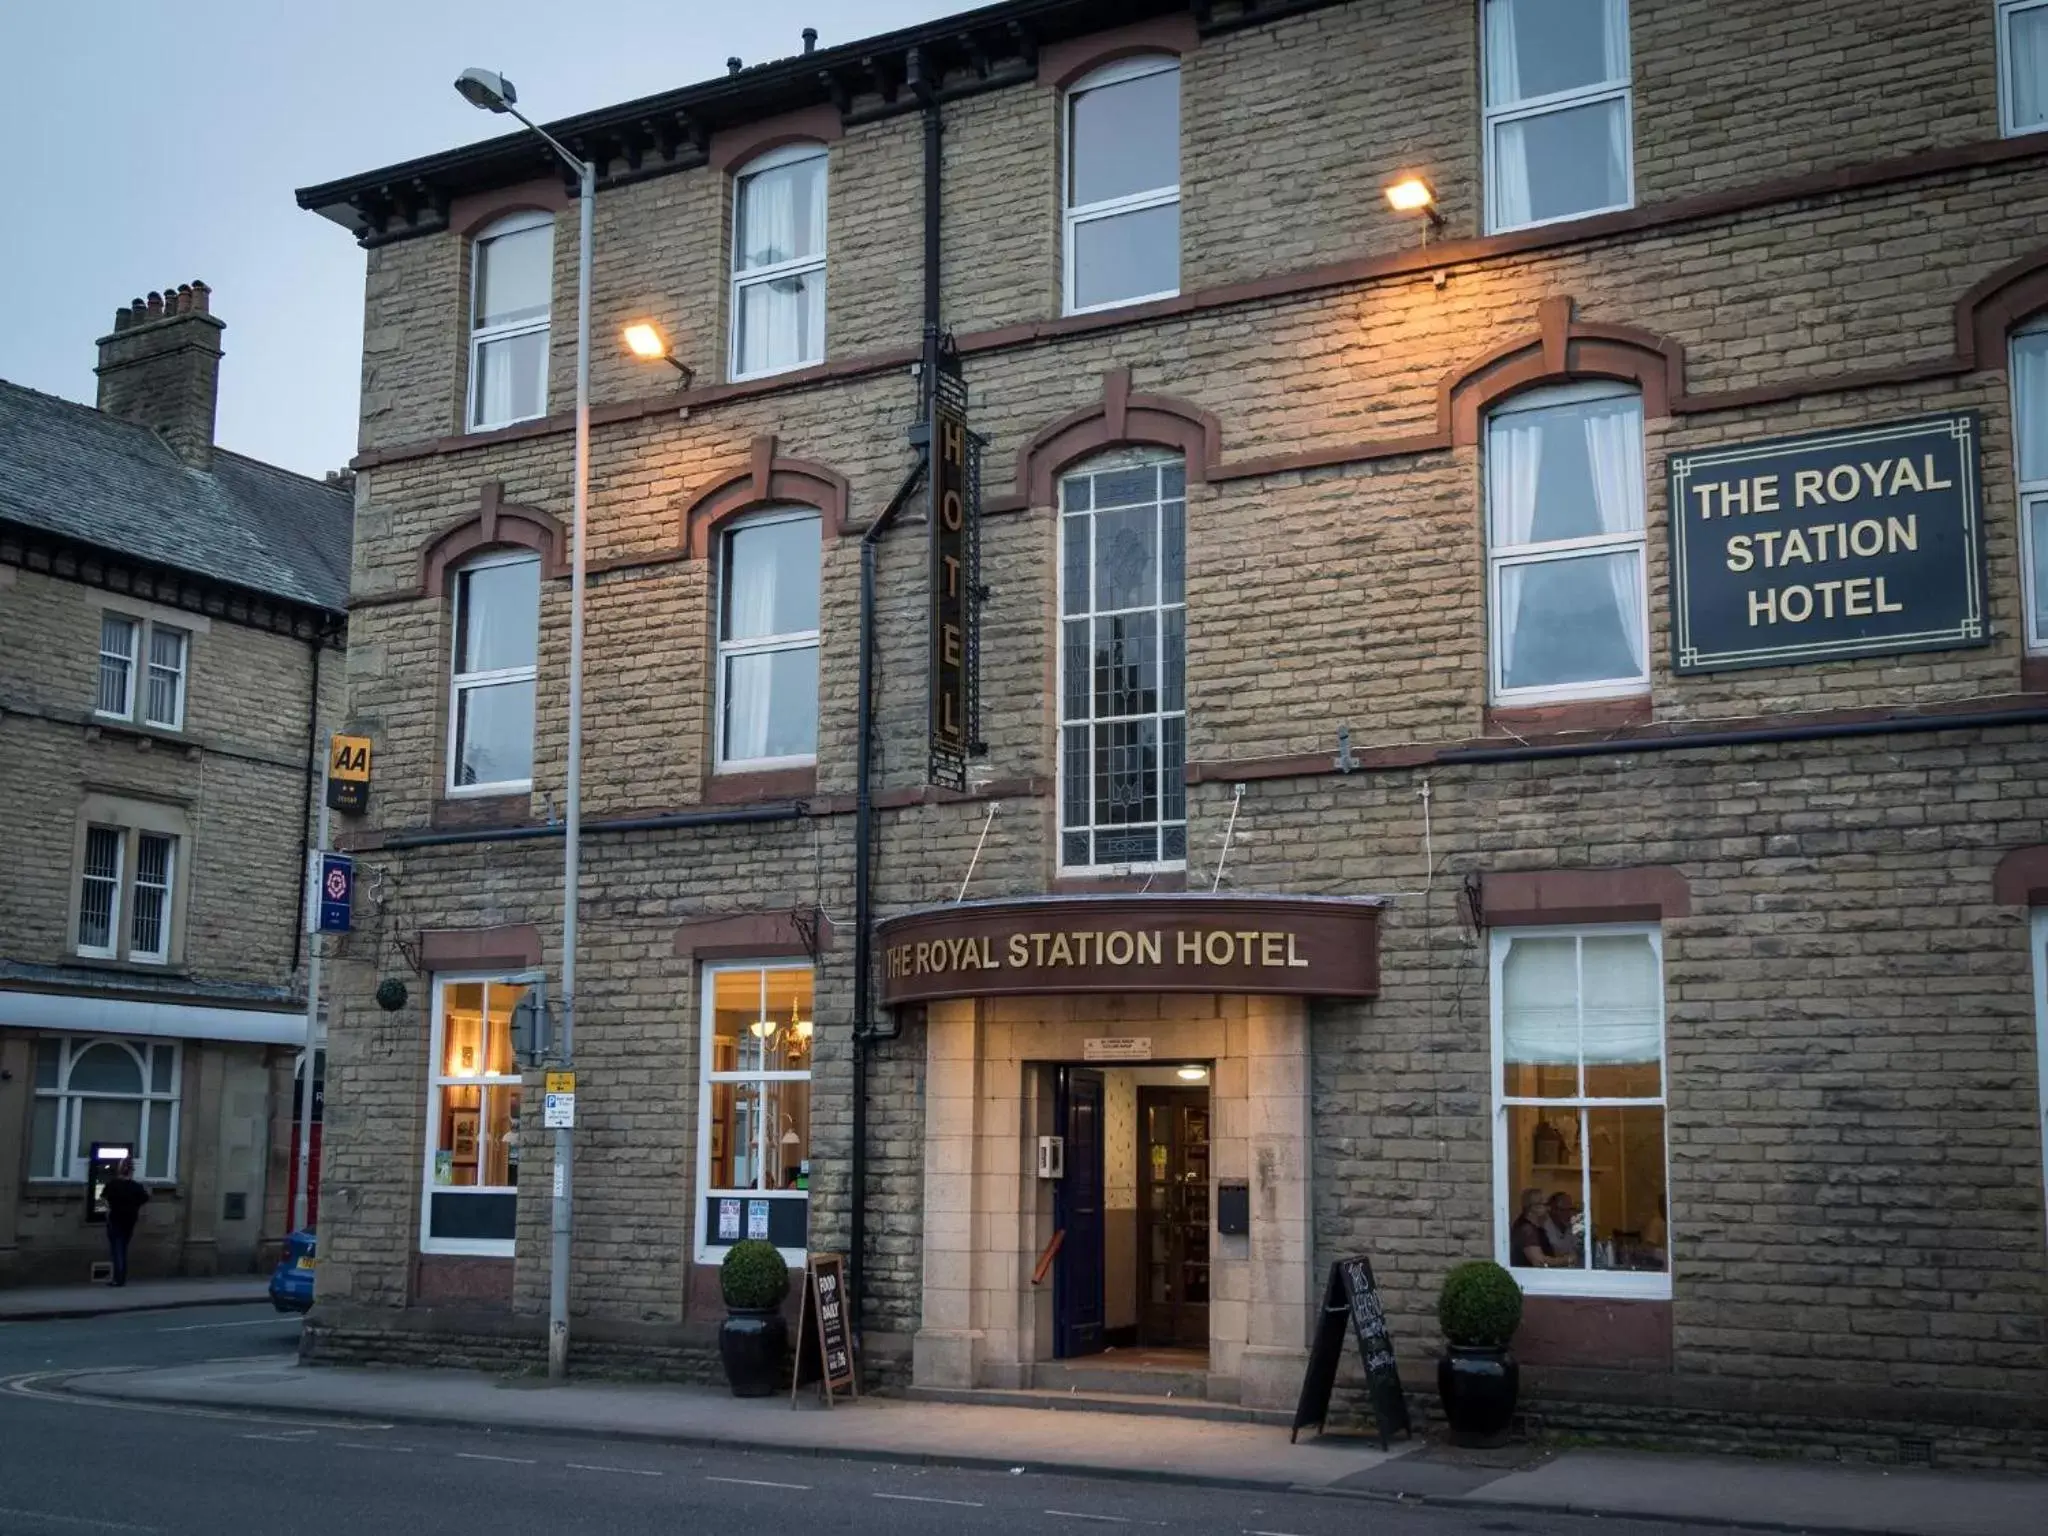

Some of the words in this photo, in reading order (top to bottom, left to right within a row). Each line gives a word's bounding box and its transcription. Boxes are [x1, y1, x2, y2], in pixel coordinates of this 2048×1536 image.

[1692, 475, 1780, 519] THE
[1795, 454, 1952, 508] ROYAL
[1726, 514, 1918, 572] STATION
[943, 420, 963, 735] HOTEL
[1748, 576, 1903, 627] HOTEL
[334, 746, 367, 772] AA
[887, 944, 913, 979] THE
[916, 936, 1000, 974] ROYAL
[1008, 931, 1162, 968] STATION
[1177, 930, 1309, 968] HOTEL
